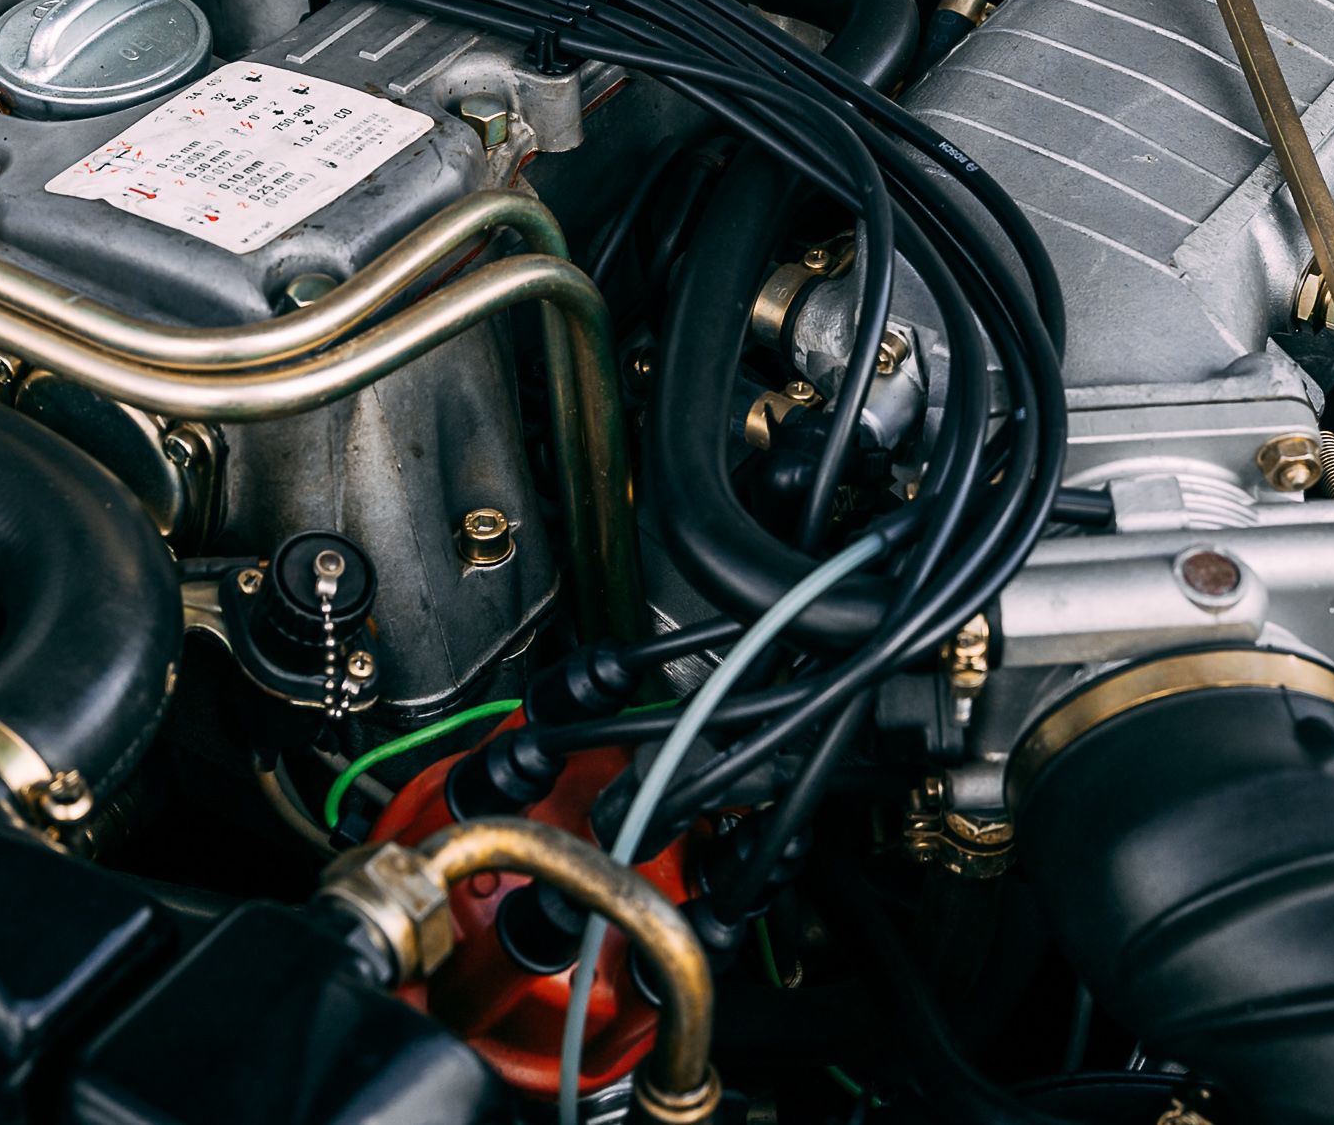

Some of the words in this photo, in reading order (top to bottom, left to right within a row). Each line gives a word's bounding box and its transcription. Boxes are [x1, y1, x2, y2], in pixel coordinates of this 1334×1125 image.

[232, 94, 259, 111] 4500
[271, 103, 316, 132] 750-850
[333, 107, 354, 120] CO
[178, 140, 202, 155] mm
[938, 141, 969, 164] BOSCH
[208, 149, 232, 164] mm
[242, 159, 265, 175] mm
[272, 171, 296, 186] mm
